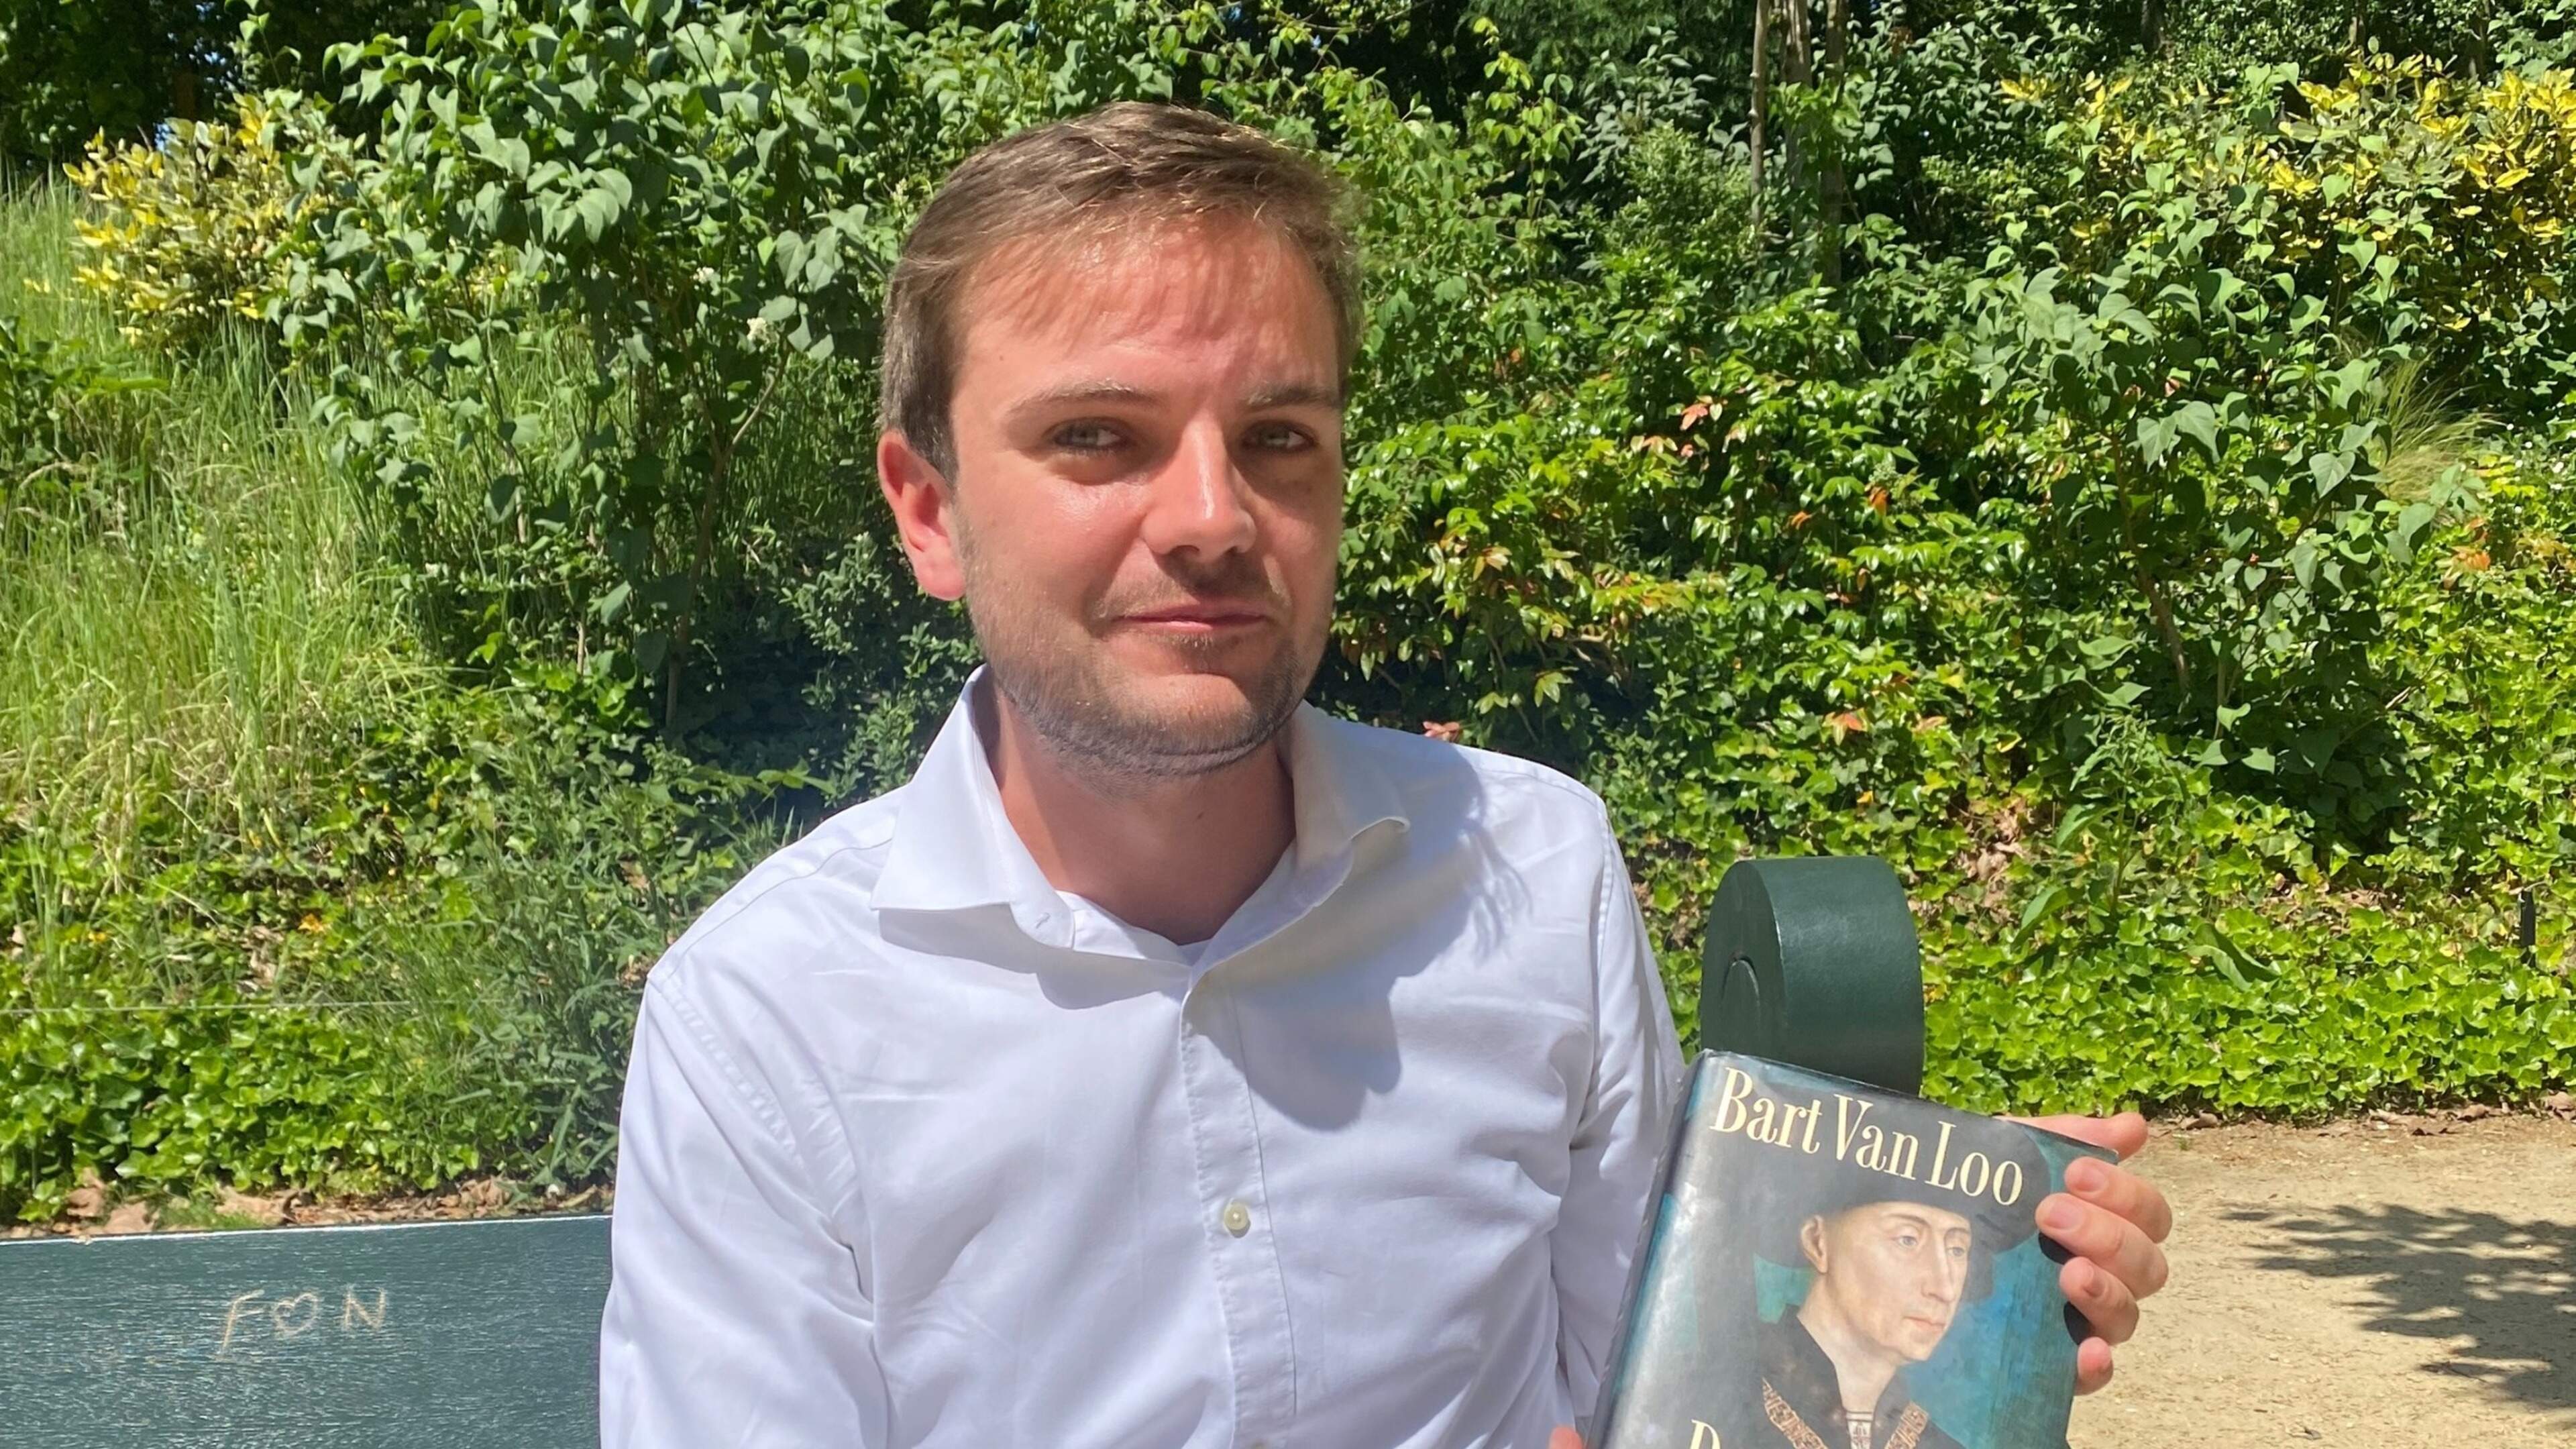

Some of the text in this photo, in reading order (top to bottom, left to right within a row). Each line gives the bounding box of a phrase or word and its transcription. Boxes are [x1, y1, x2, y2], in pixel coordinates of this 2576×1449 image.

[1710, 1067, 2023, 1205] Bart Van Loo
